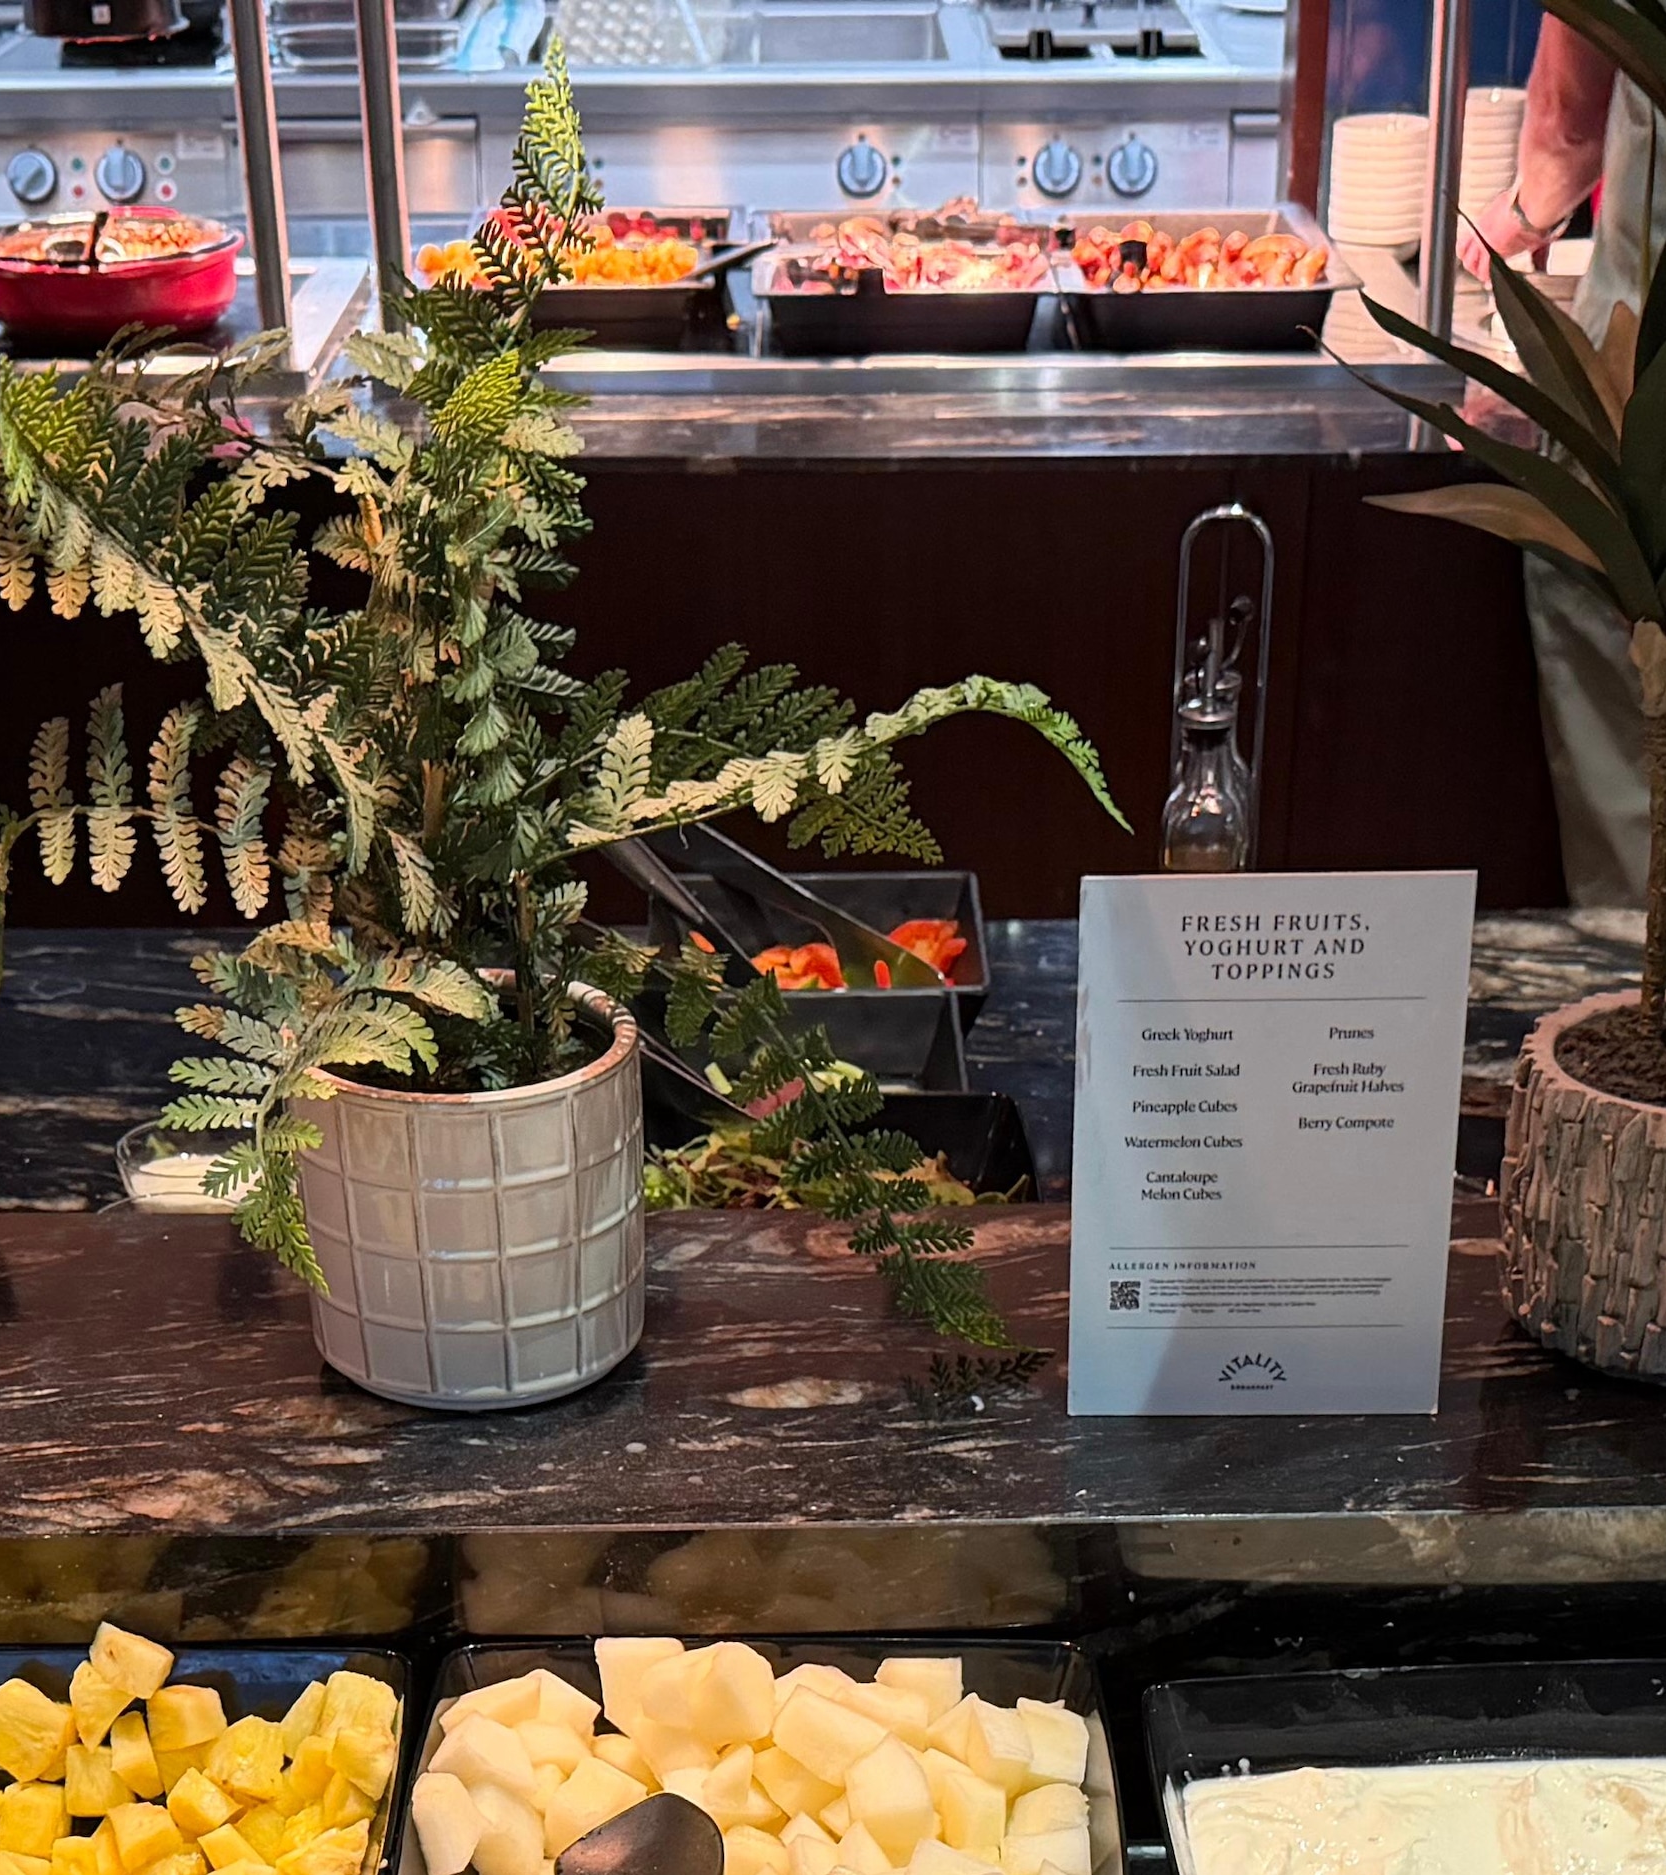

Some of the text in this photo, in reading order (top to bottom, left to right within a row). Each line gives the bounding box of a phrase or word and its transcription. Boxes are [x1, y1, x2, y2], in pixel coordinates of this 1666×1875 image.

[1182, 914, 1369, 932] FRESH FRUITS,
[1184, 938, 1364, 956] YOGHURT AND
[1211, 963, 1334, 980] TOPPINGS
[1142, 1028, 1233, 1043] Greek Yoghurt
[1329, 1027, 1374, 1040] Prunes
[1133, 1064, 1240, 1077] Fresh Fruit Salad
[1314, 1063, 1386, 1078] Fresh Ruby
[1292, 1080, 1404, 1096] Grapefruit Halves
[1133, 1100, 1238, 1116] Pineapple Cubes
[1299, 1116, 1394, 1131] Berry Compote
[1125, 1136, 1243, 1148] Watermelon Cubes
[1146, 1171, 1218, 1186] Cantaloupe
[1141, 1188, 1222, 1200] Melon Cubes
[1218, 1353, 1287, 1382] VITALITY
